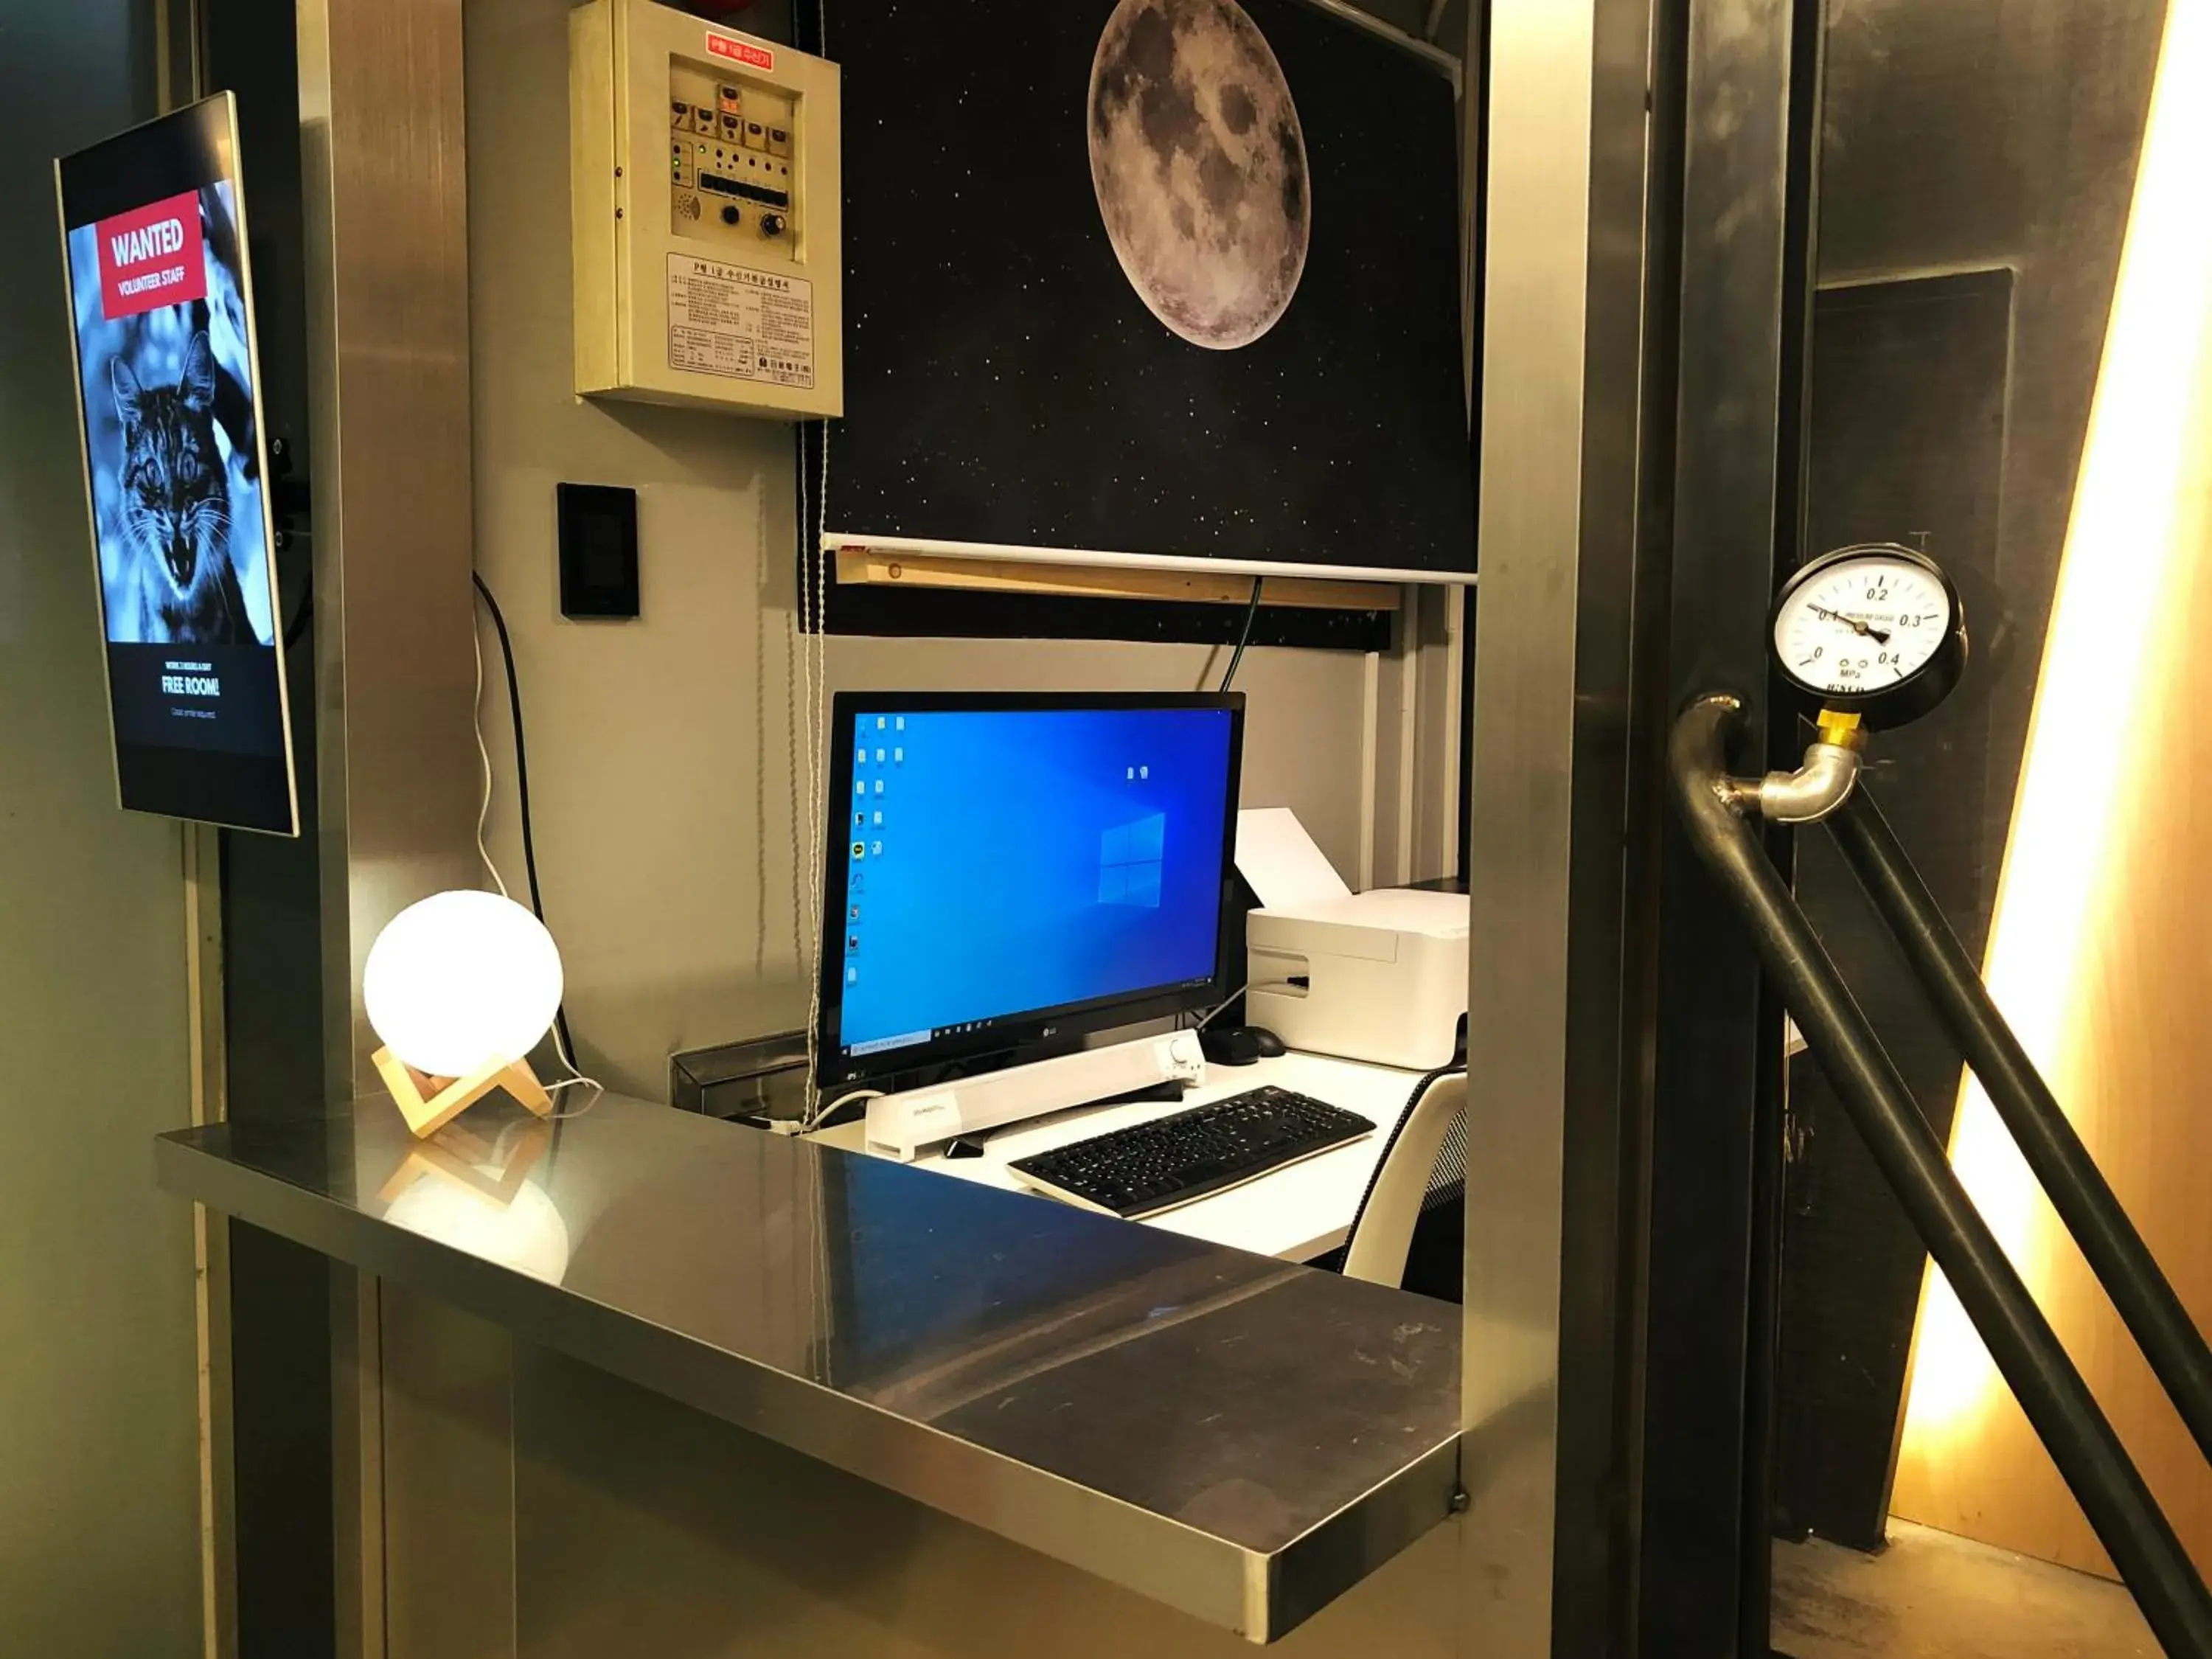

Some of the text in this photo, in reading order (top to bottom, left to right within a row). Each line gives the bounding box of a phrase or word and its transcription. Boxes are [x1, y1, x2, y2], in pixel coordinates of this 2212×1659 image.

[111, 218, 184, 268] WANTED
[118, 265, 184, 296] VOLUNTEER STAFF
[1866, 588, 1888, 601] 0.2
[1818, 610, 1839, 622] 0.1
[1899, 614, 1921, 628] 0.3
[1813, 646, 1823, 659] 0
[1878, 652, 1900, 665] 0.4
[161, 675, 220, 696] FREE ROOM!
